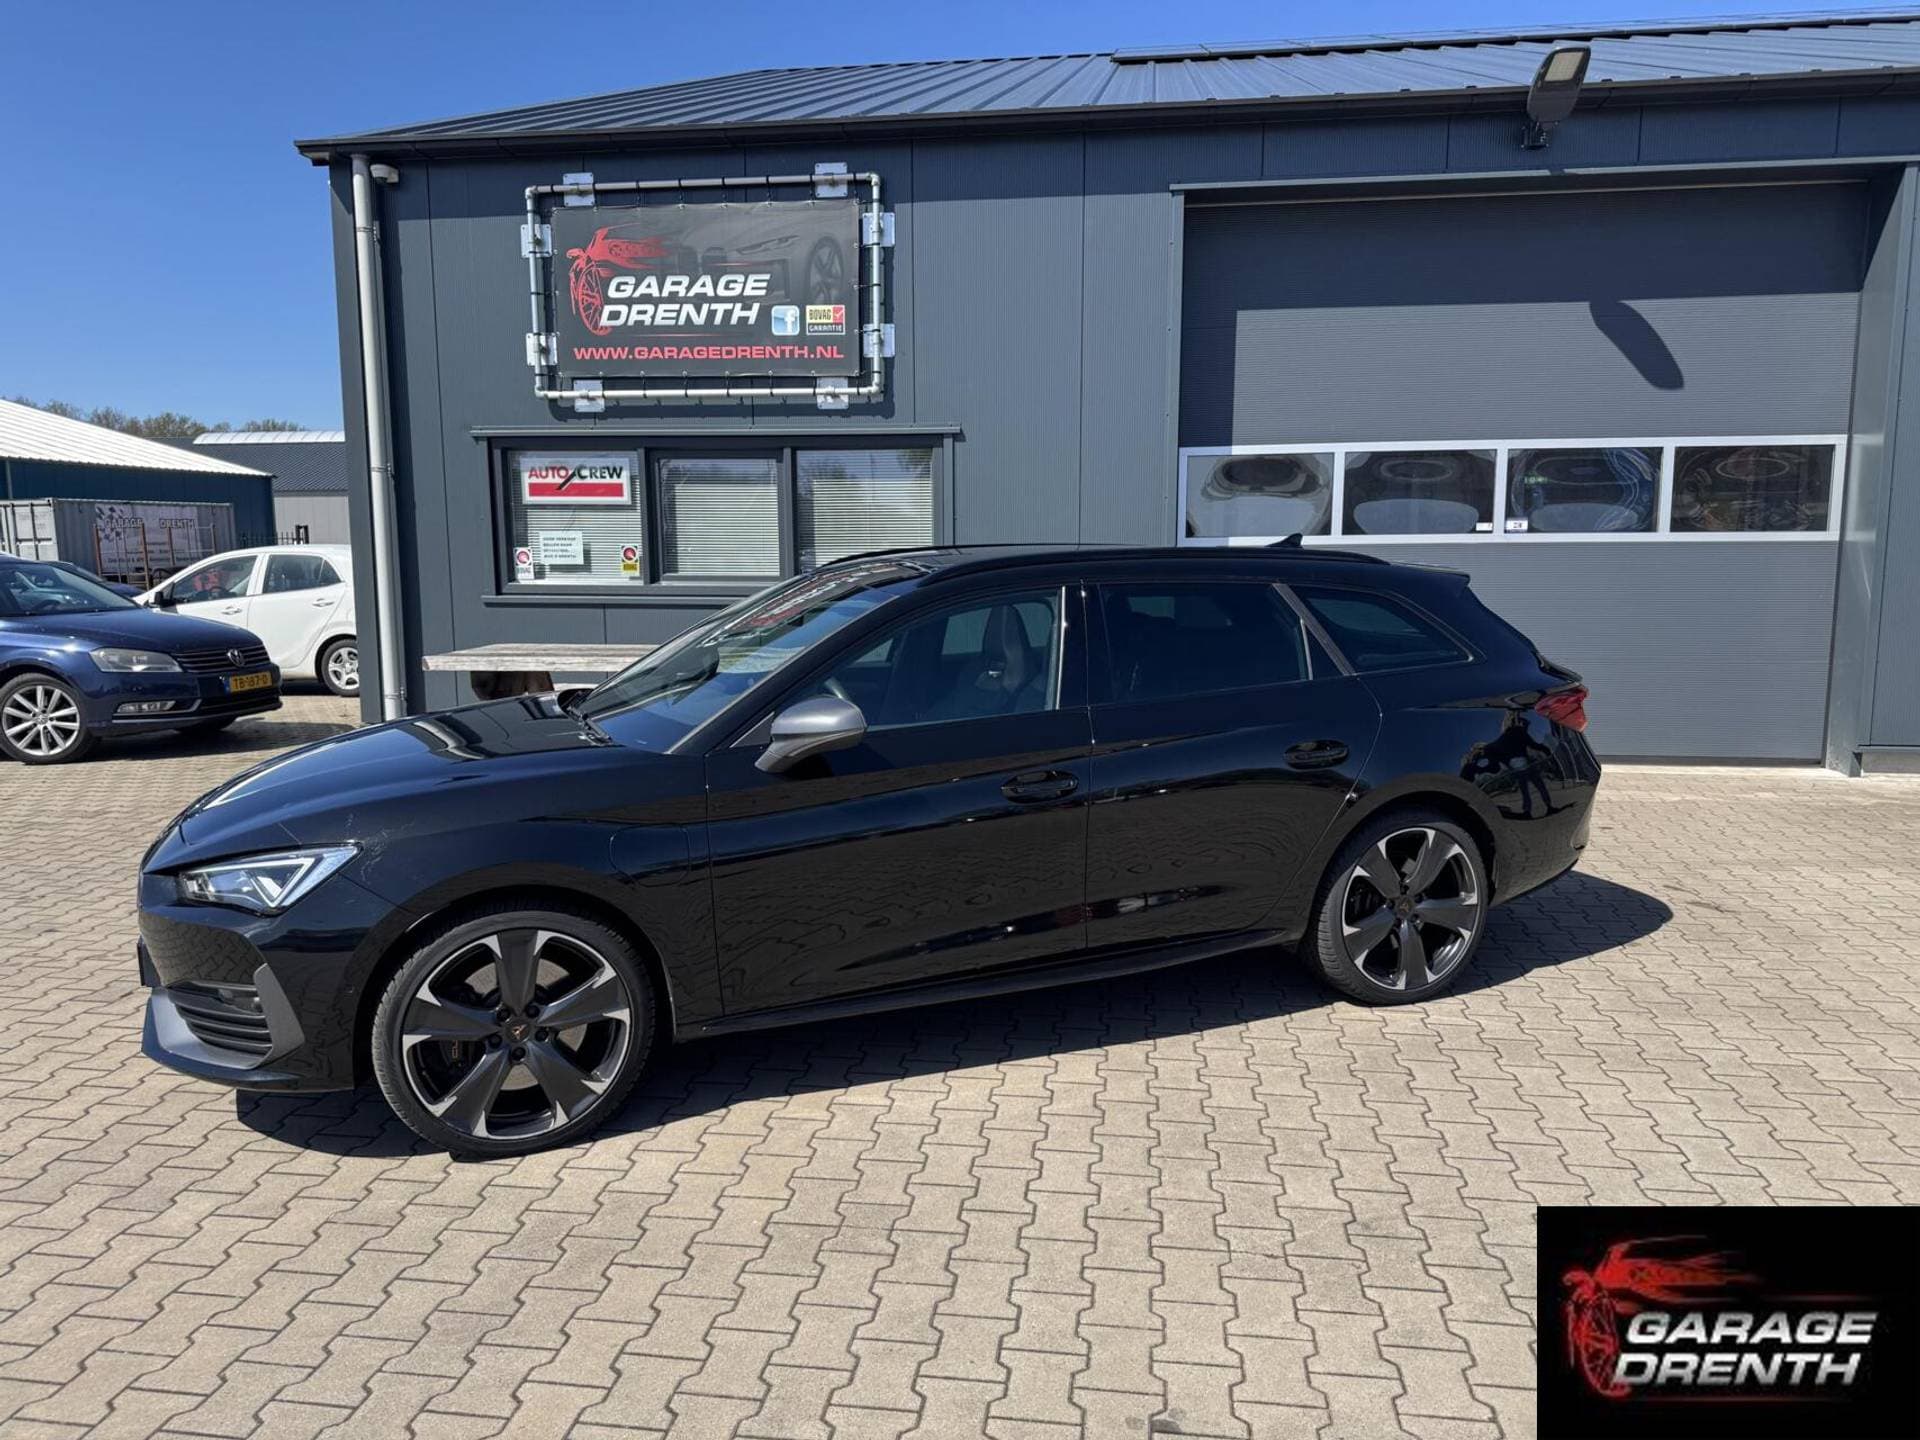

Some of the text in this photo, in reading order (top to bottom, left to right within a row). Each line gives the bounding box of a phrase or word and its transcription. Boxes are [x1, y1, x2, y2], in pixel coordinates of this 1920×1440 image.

[607, 273, 771, 298] GARAGE
[600, 303, 760, 326] DRENTH
[808, 308, 832, 321] BOVAG
[573, 345, 844, 360] WWW.GARAGEDRENTH.NL
[528, 464, 624, 480] AUTO CREW
